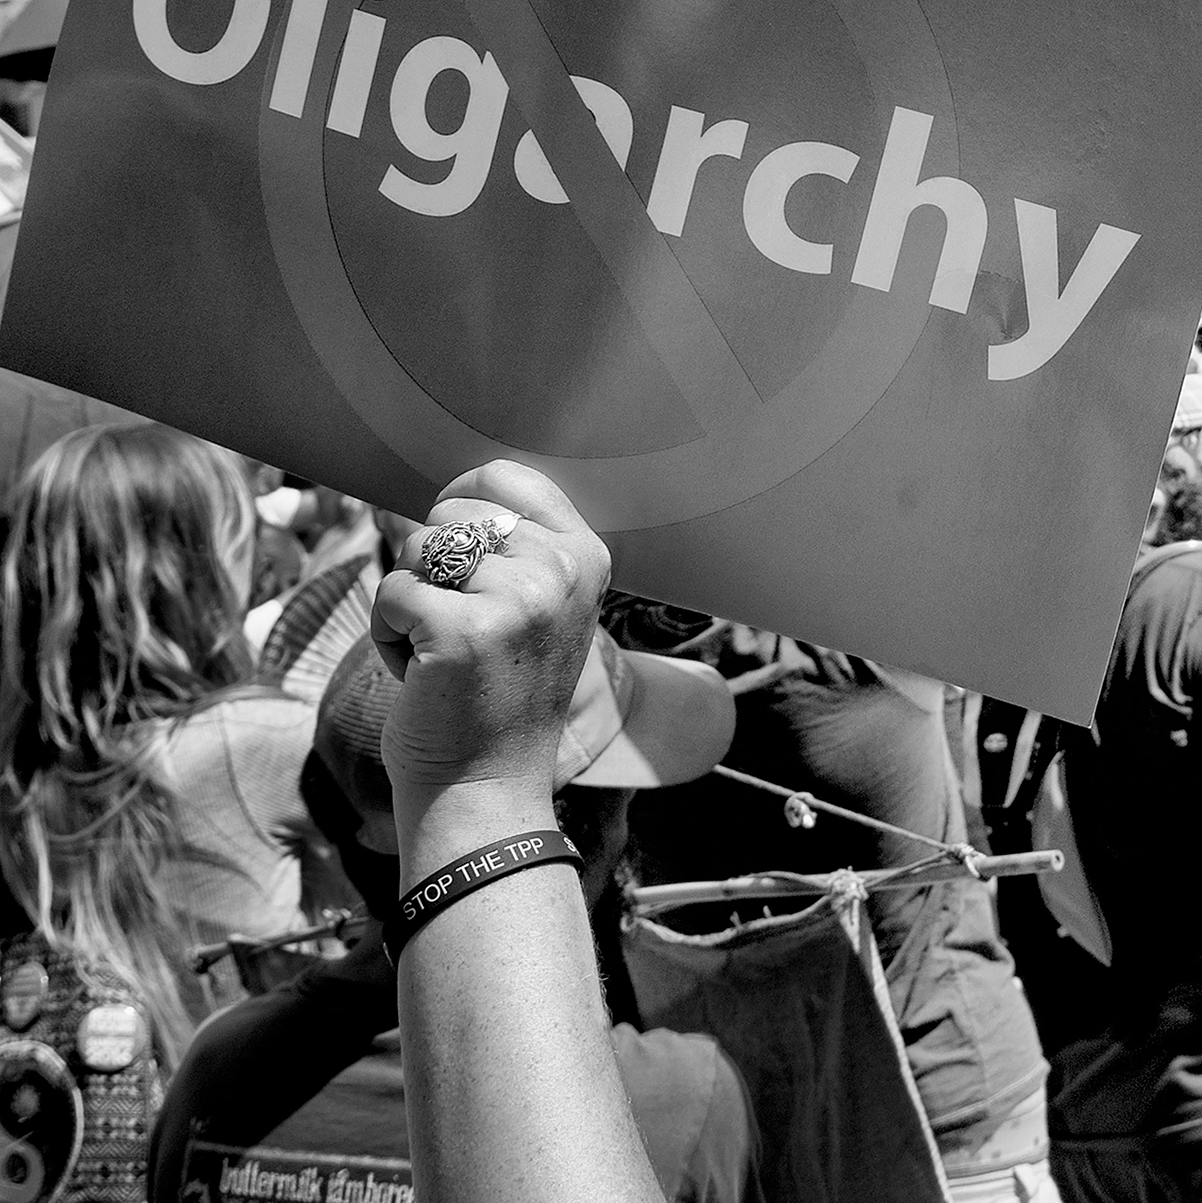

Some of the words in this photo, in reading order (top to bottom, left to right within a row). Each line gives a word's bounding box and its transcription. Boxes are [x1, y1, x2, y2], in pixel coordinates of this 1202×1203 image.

[402, 874, 454, 921] STOP
[455, 849, 506, 883] THE
[504, 837, 545, 862] TPP
